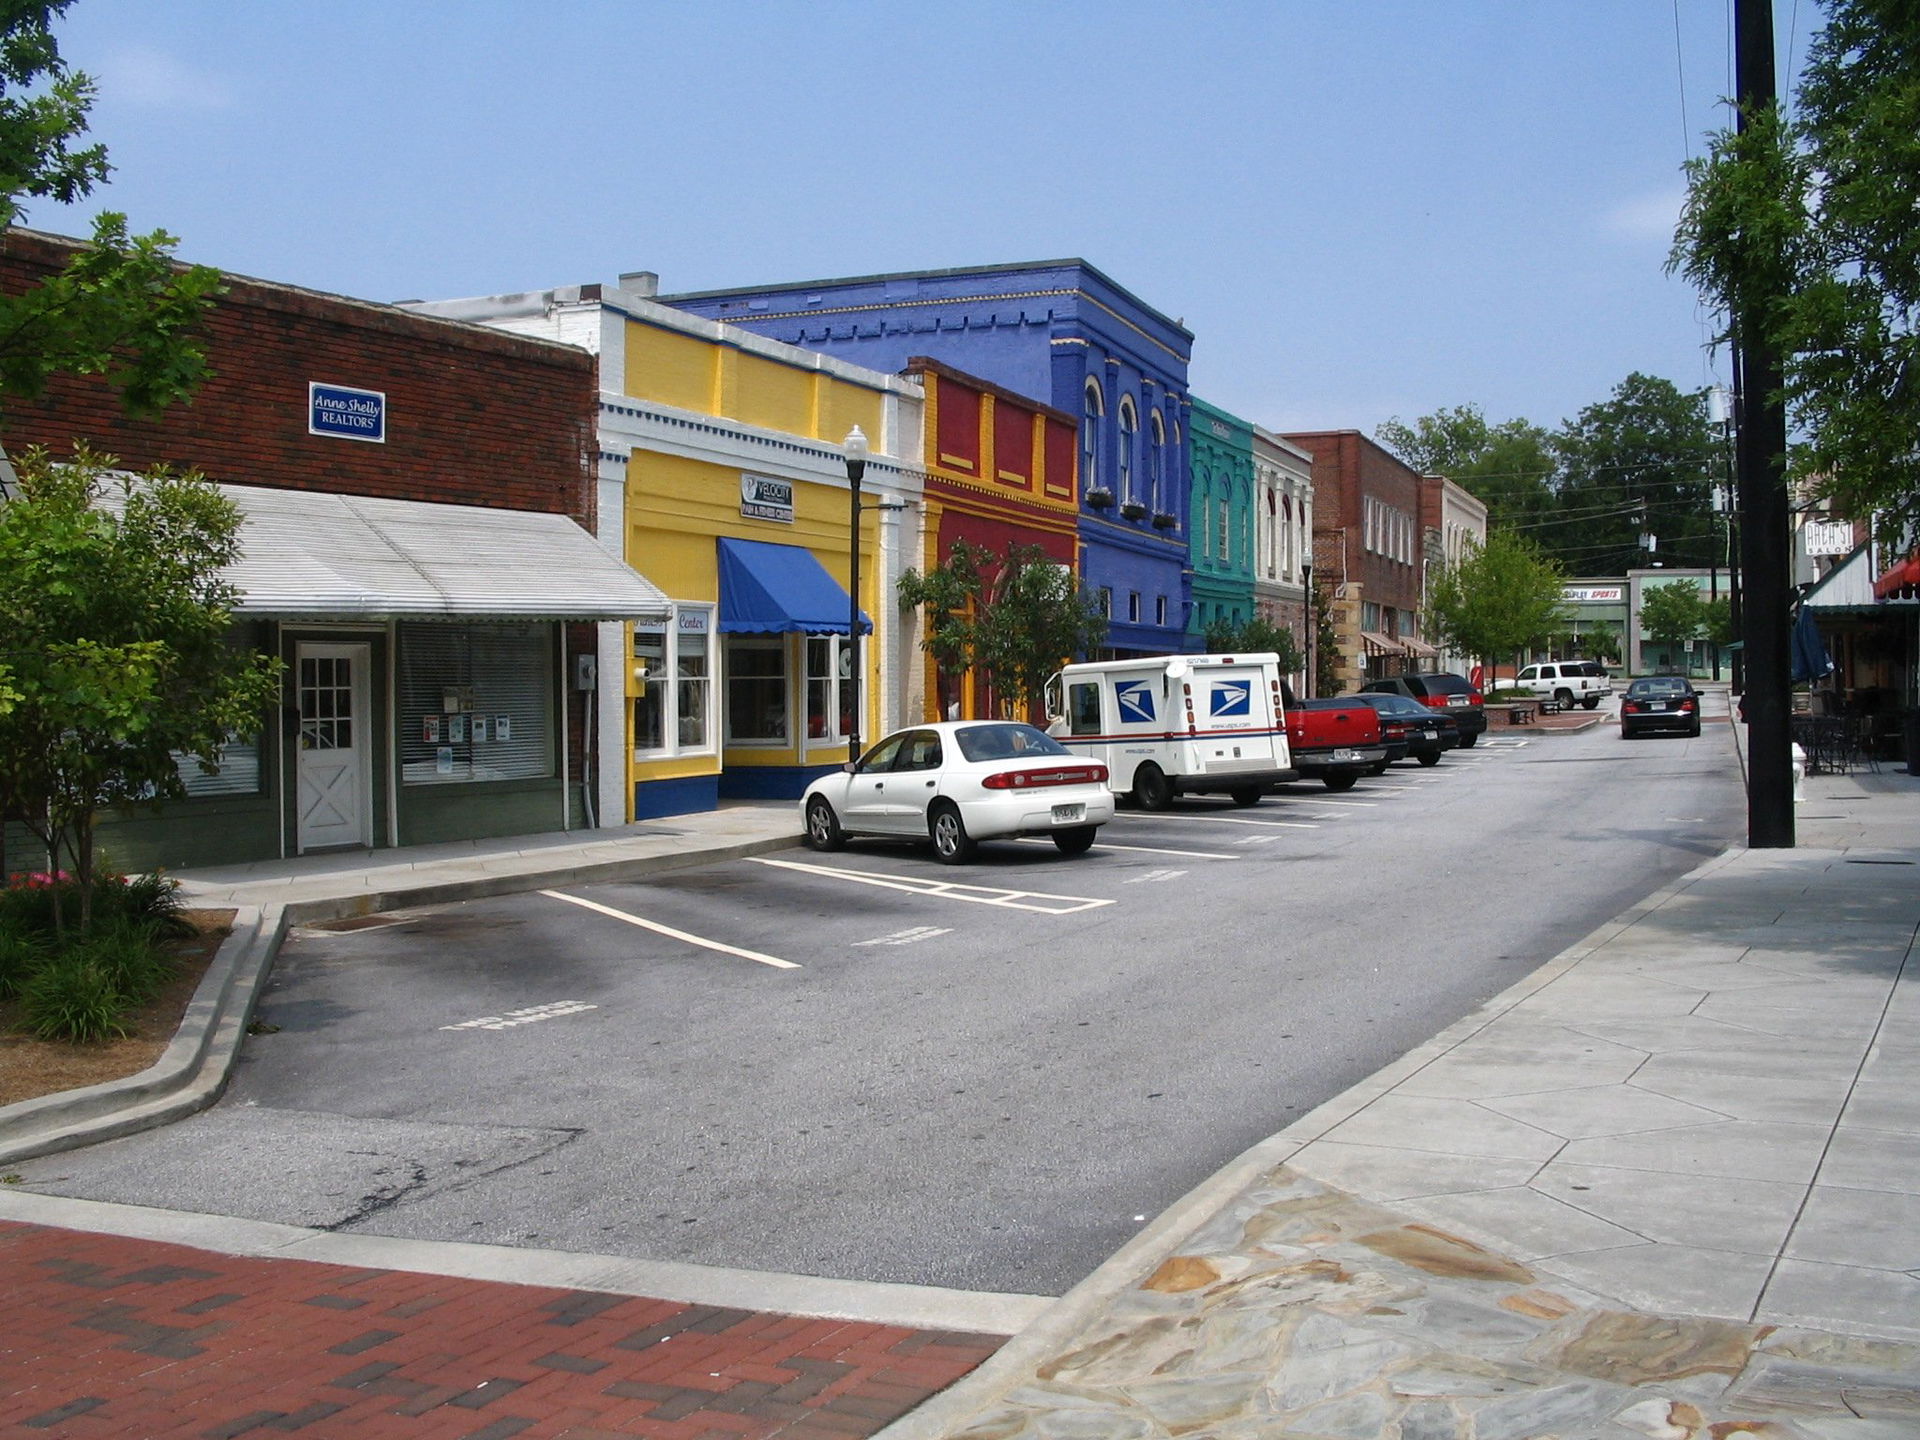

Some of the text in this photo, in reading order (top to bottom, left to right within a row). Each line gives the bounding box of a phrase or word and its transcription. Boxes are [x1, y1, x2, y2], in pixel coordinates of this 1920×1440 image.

[315, 395, 379, 417] Anne Shelly
[322, 411, 374, 428] REALTORS
[1808, 545, 1852, 553] SALON
[679, 614, 703, 629] Center
